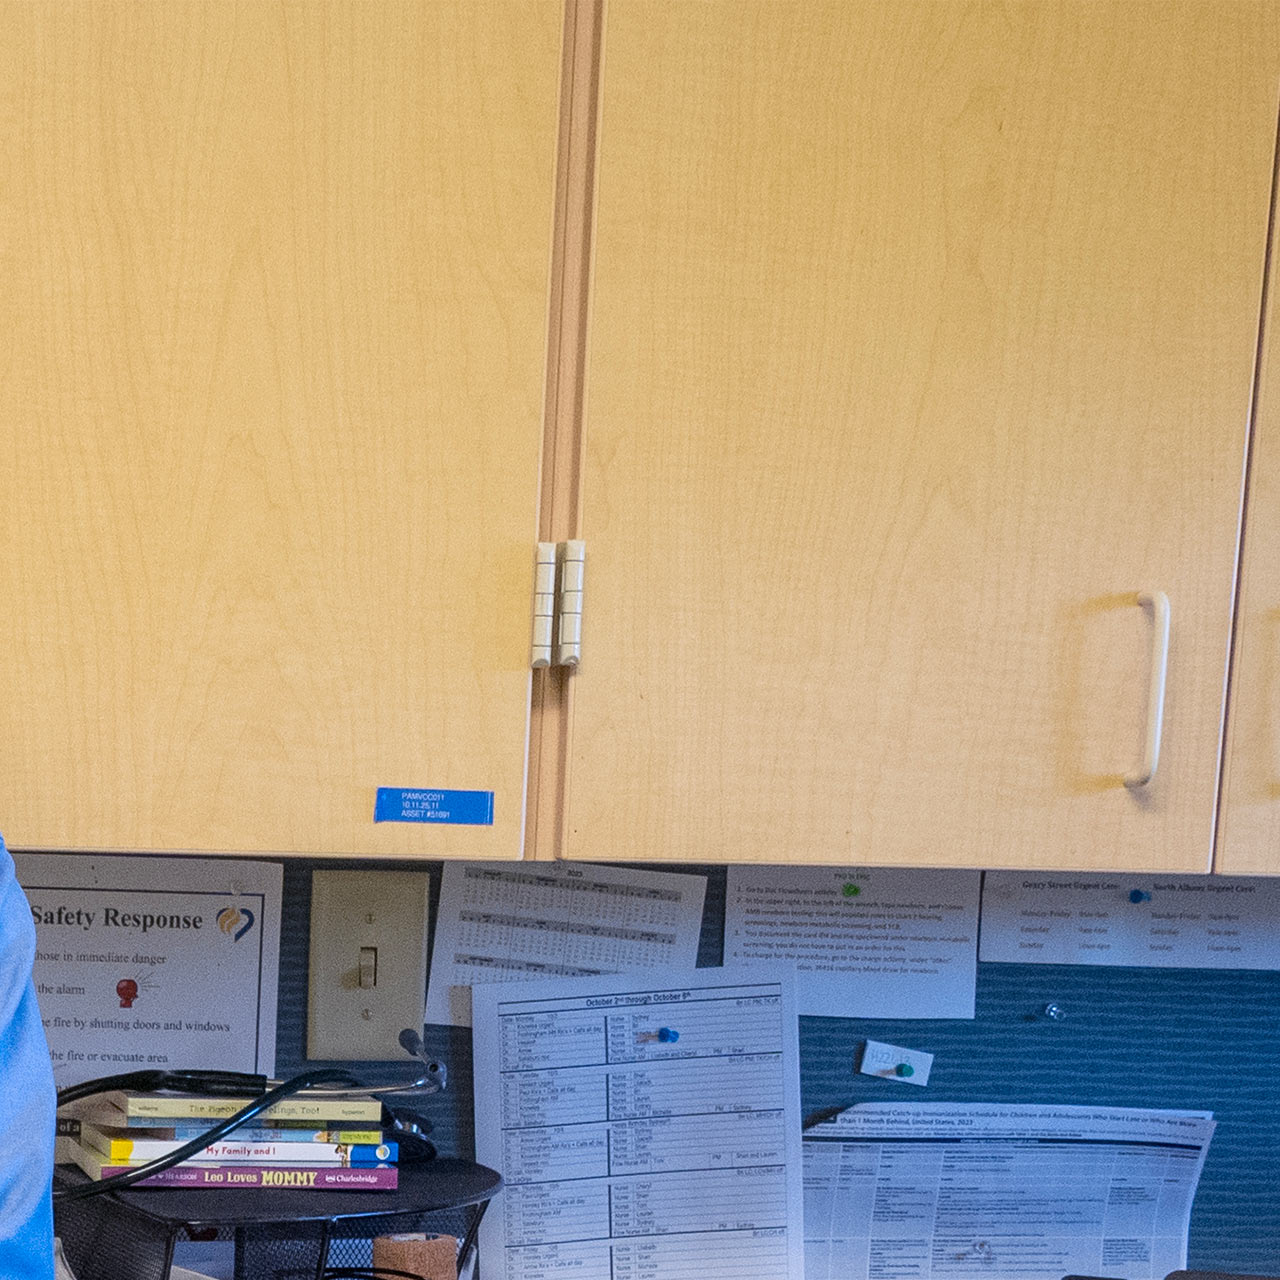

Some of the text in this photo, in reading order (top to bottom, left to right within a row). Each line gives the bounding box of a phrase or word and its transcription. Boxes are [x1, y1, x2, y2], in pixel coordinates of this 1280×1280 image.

[401, 809, 424, 818] ASSET
[30, 906, 203, 932] Safety Response
[36, 949, 167, 967] hose in immediate danger
[38, 983, 86, 996] the alarm
[653, 993, 680, 1003] October
[54, 1017, 72, 1028] fire
[74, 1018, 86, 1032] by
[90, 1019, 130, 1033] shutting
[133, 1019, 161, 1031] doors
[164, 1021, 185, 1032] and
[186, 1021, 232, 1033] windows
[67, 1050, 85, 1061] fire
[87, 1053, 98, 1061] or
[100, 1052, 144, 1063] evacuate
[147, 1054, 169, 1064] area
[205, 1146, 218, 1157] My
[222, 1146, 251, 1157] Family
[254, 1146, 270, 1155] and
[203, 1171, 318, 1186] Leo Loves MOMMY
